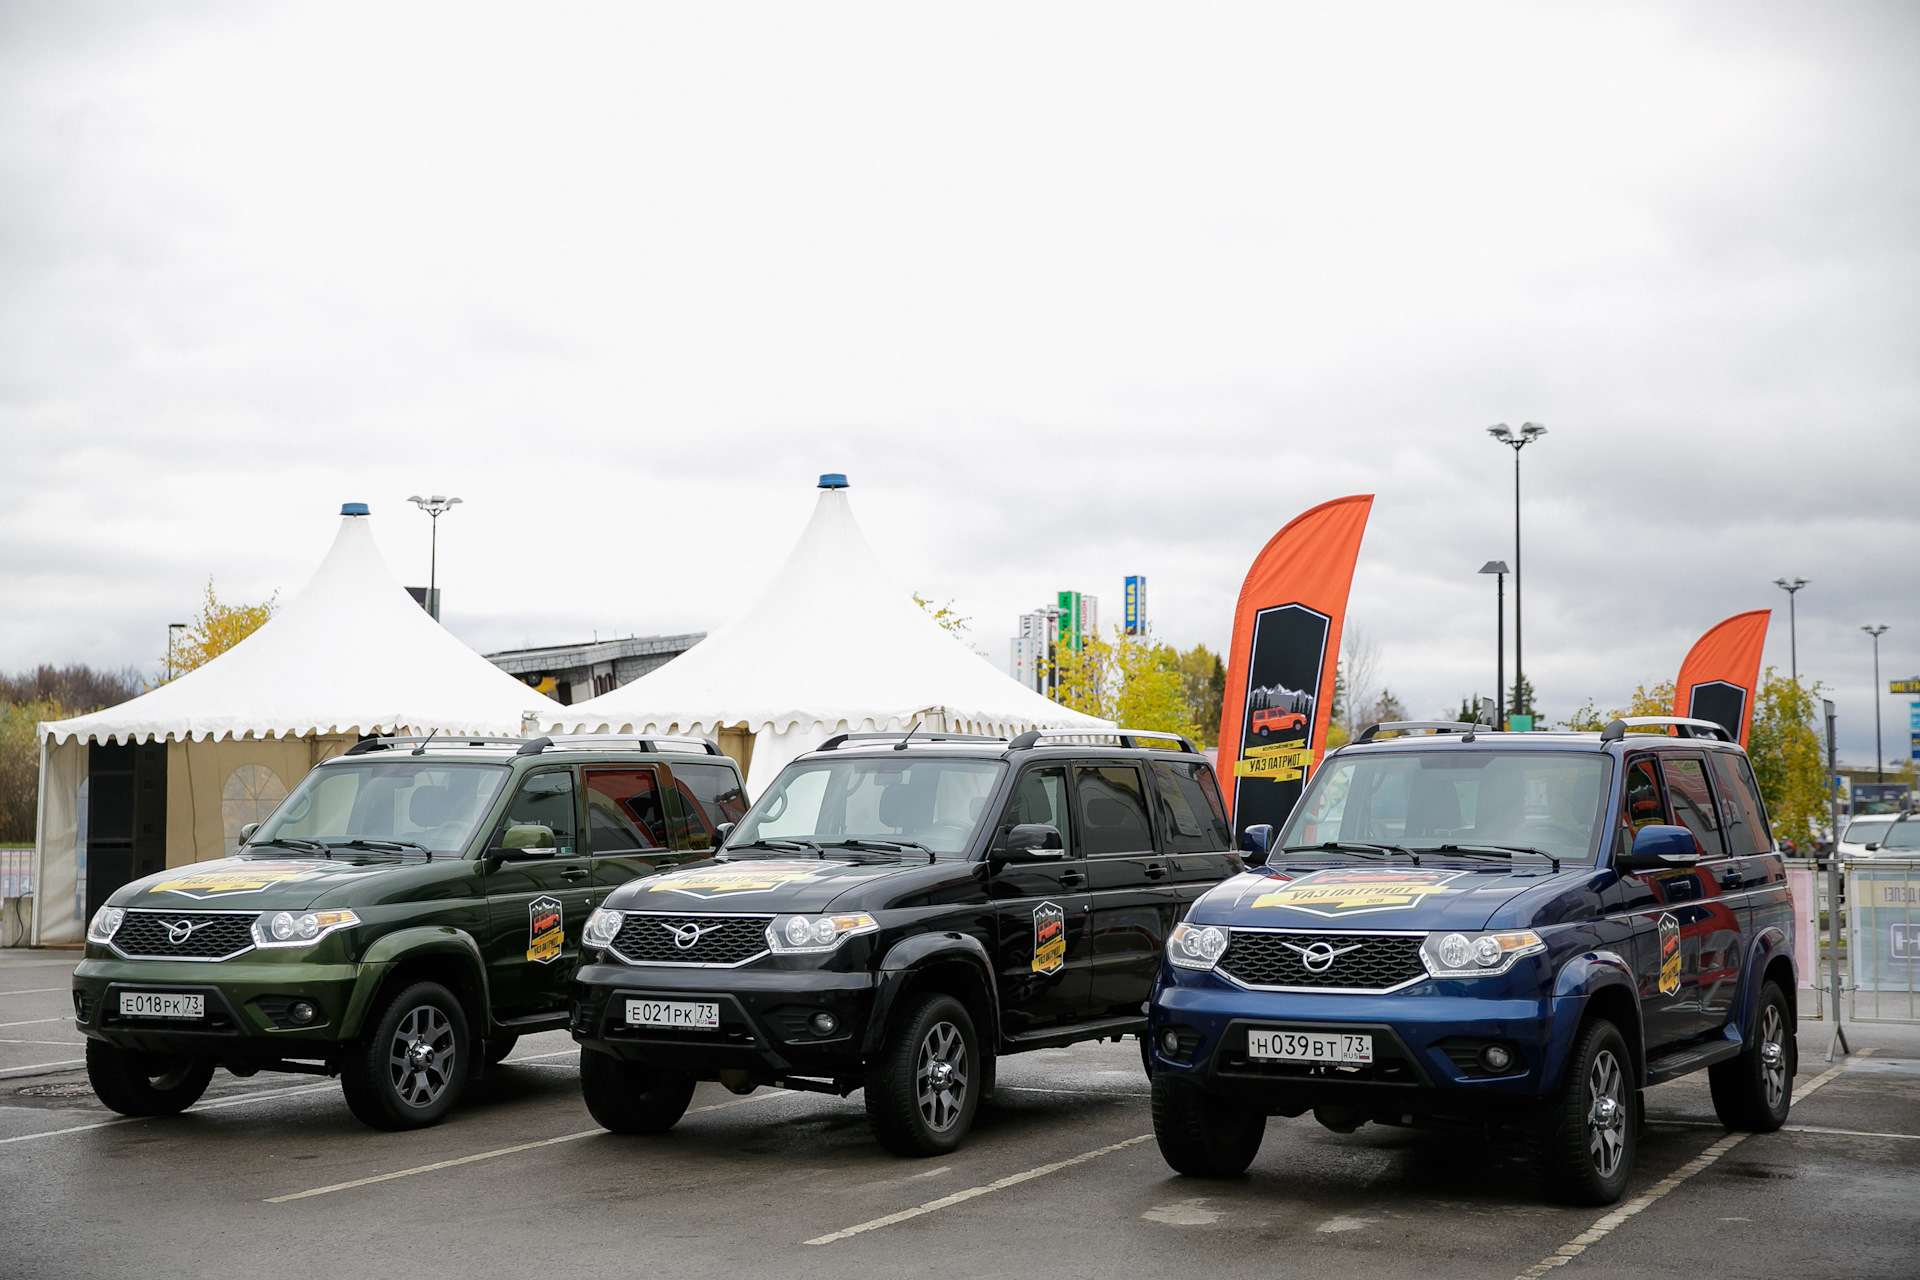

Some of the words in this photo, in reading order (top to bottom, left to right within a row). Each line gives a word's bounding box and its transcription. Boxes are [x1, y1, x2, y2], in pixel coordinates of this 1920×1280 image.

[1127, 584, 1136, 621] IKEA
[1250, 759, 1266, 772] УАЗ
[1267, 753, 1301, 770] ПАТРИОТ
[1290, 890, 1329, 901] УАЗ
[1329, 886, 1417, 897] ПАТРИОТ
[184, 996, 199, 1010] 73
[697, 1005, 713, 1019] 73
[1344, 1036, 1364, 1052] 73
[1343, 1052, 1359, 1060] RUS
